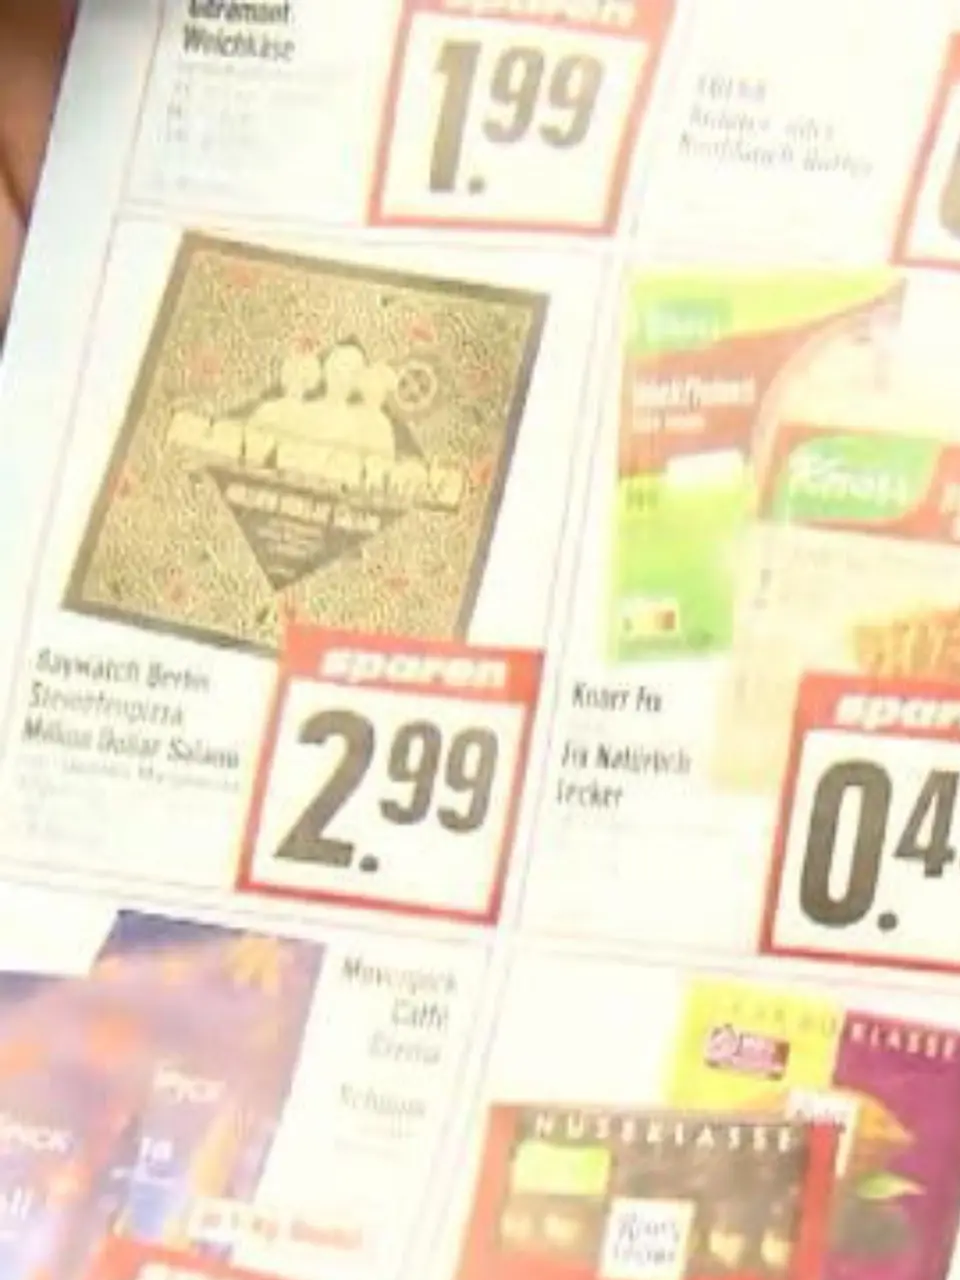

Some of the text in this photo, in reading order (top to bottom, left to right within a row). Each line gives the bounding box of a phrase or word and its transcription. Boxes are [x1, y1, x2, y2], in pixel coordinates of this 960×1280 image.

[429, 41, 607, 196] 1.99
[320, 647, 508, 691] sparen
[271, 709, 500, 874] 2.99
